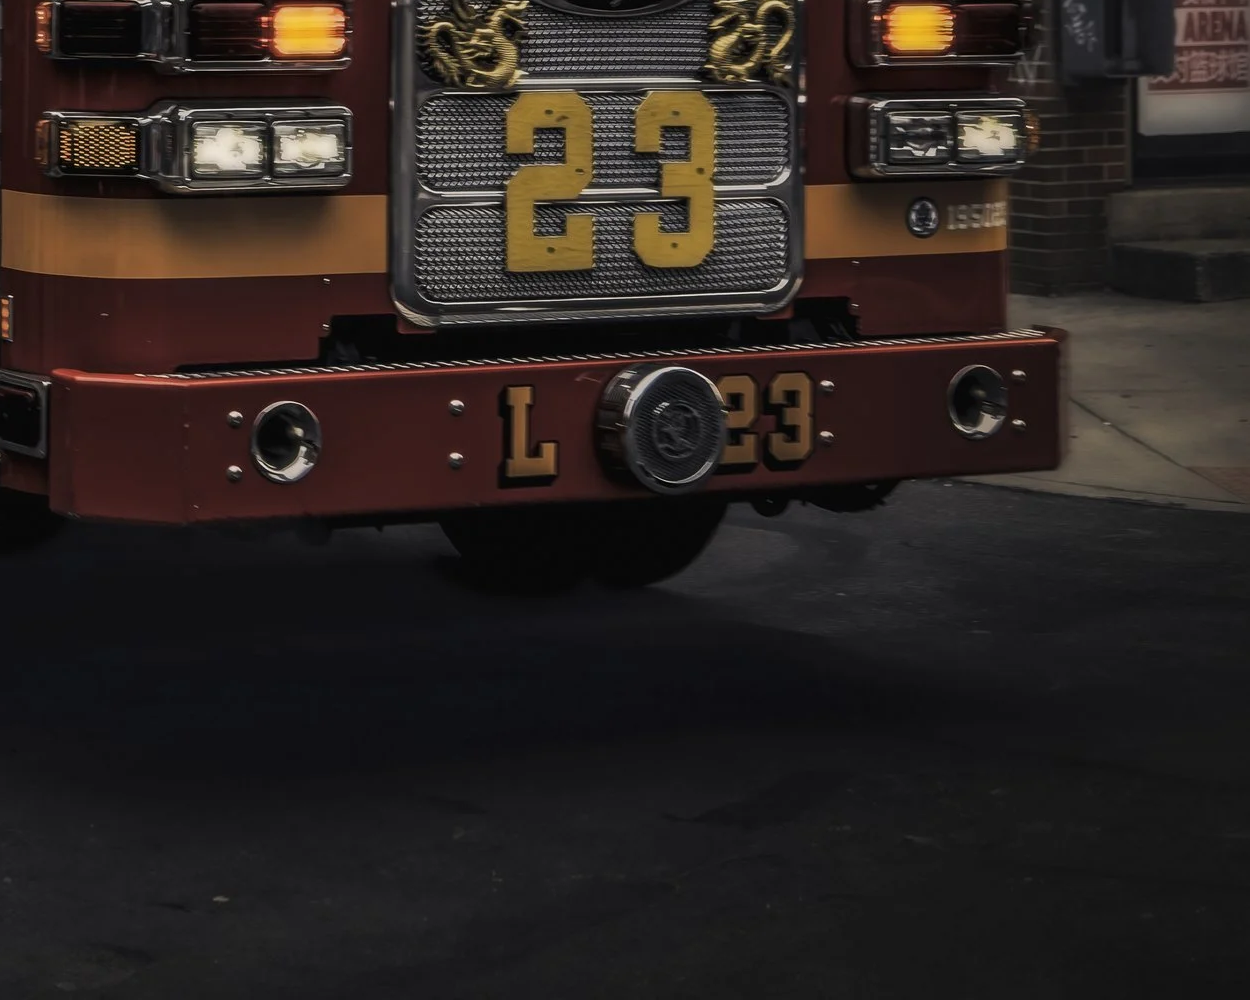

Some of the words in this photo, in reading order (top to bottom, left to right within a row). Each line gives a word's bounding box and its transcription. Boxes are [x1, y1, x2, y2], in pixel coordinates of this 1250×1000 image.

[1182, 10, 1249, 43] ARENA
[505, 89, 717, 273] 23
[503, 384, 558, 480] L
[714, 372, 815, 466] 23
